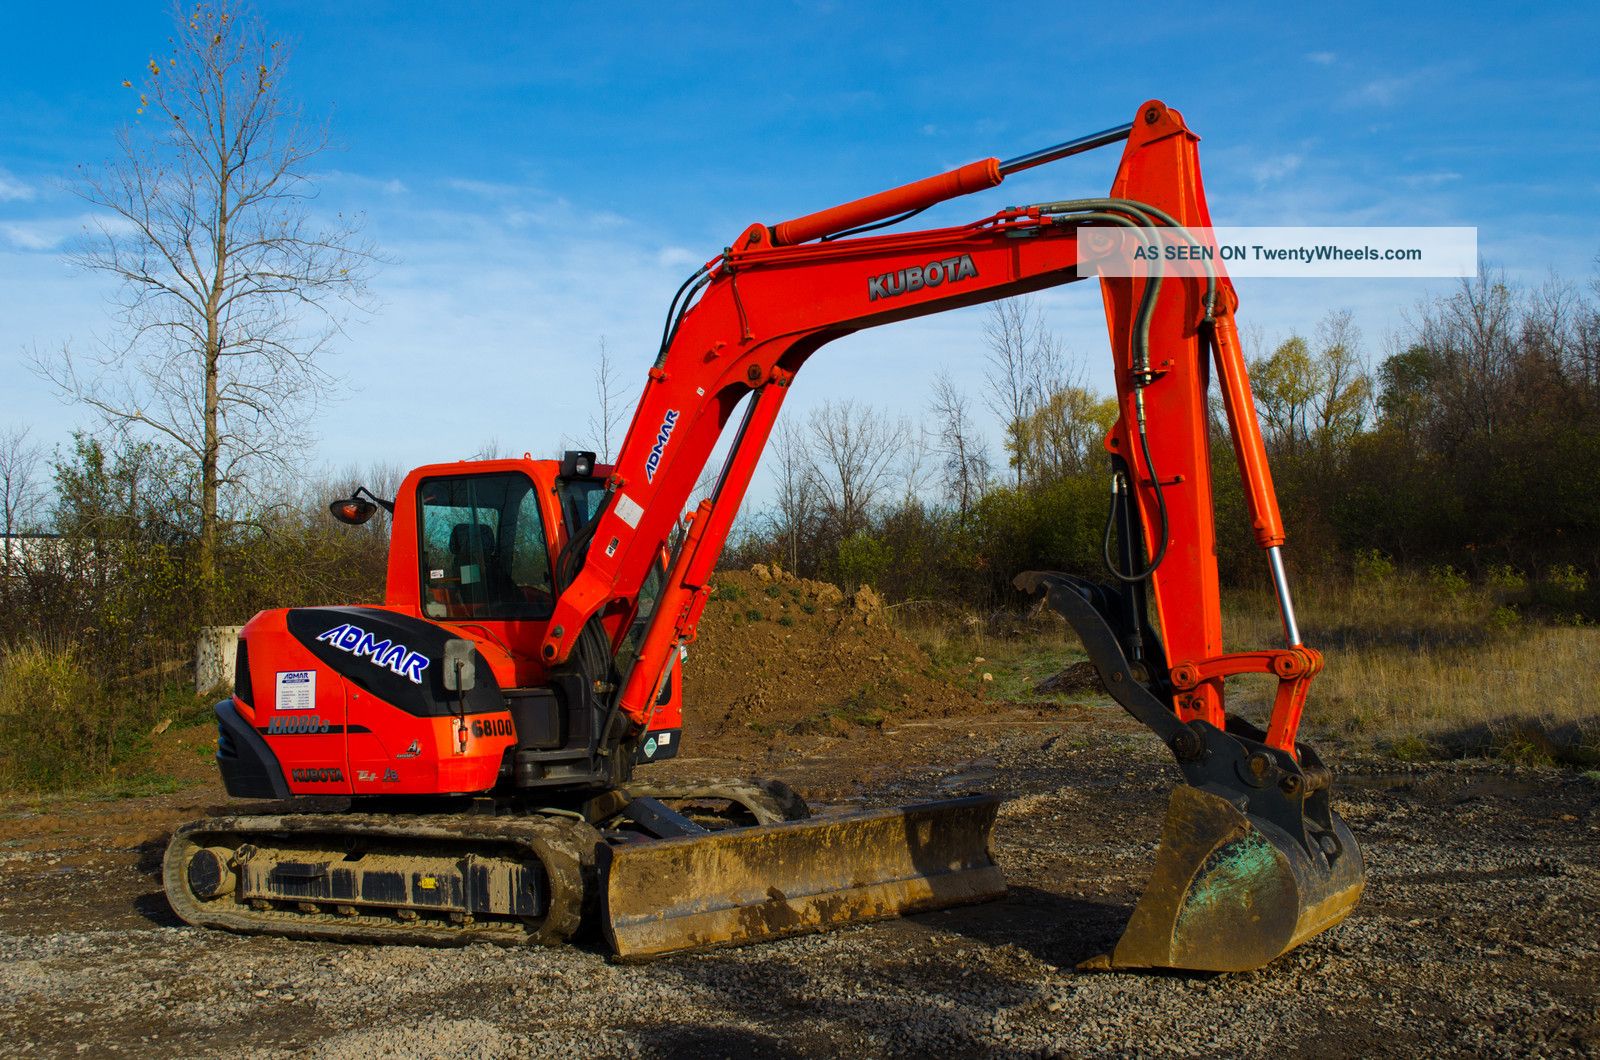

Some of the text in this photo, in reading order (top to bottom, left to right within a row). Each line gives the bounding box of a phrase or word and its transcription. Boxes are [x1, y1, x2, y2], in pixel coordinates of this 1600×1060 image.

[868, 254, 979, 302] KUBOTA
[645, 408, 680, 485] ADMAR
[316, 623, 430, 684] ADMAR
[471, 719, 513, 738] 68100
[291, 767, 344, 783] KUBOTA
